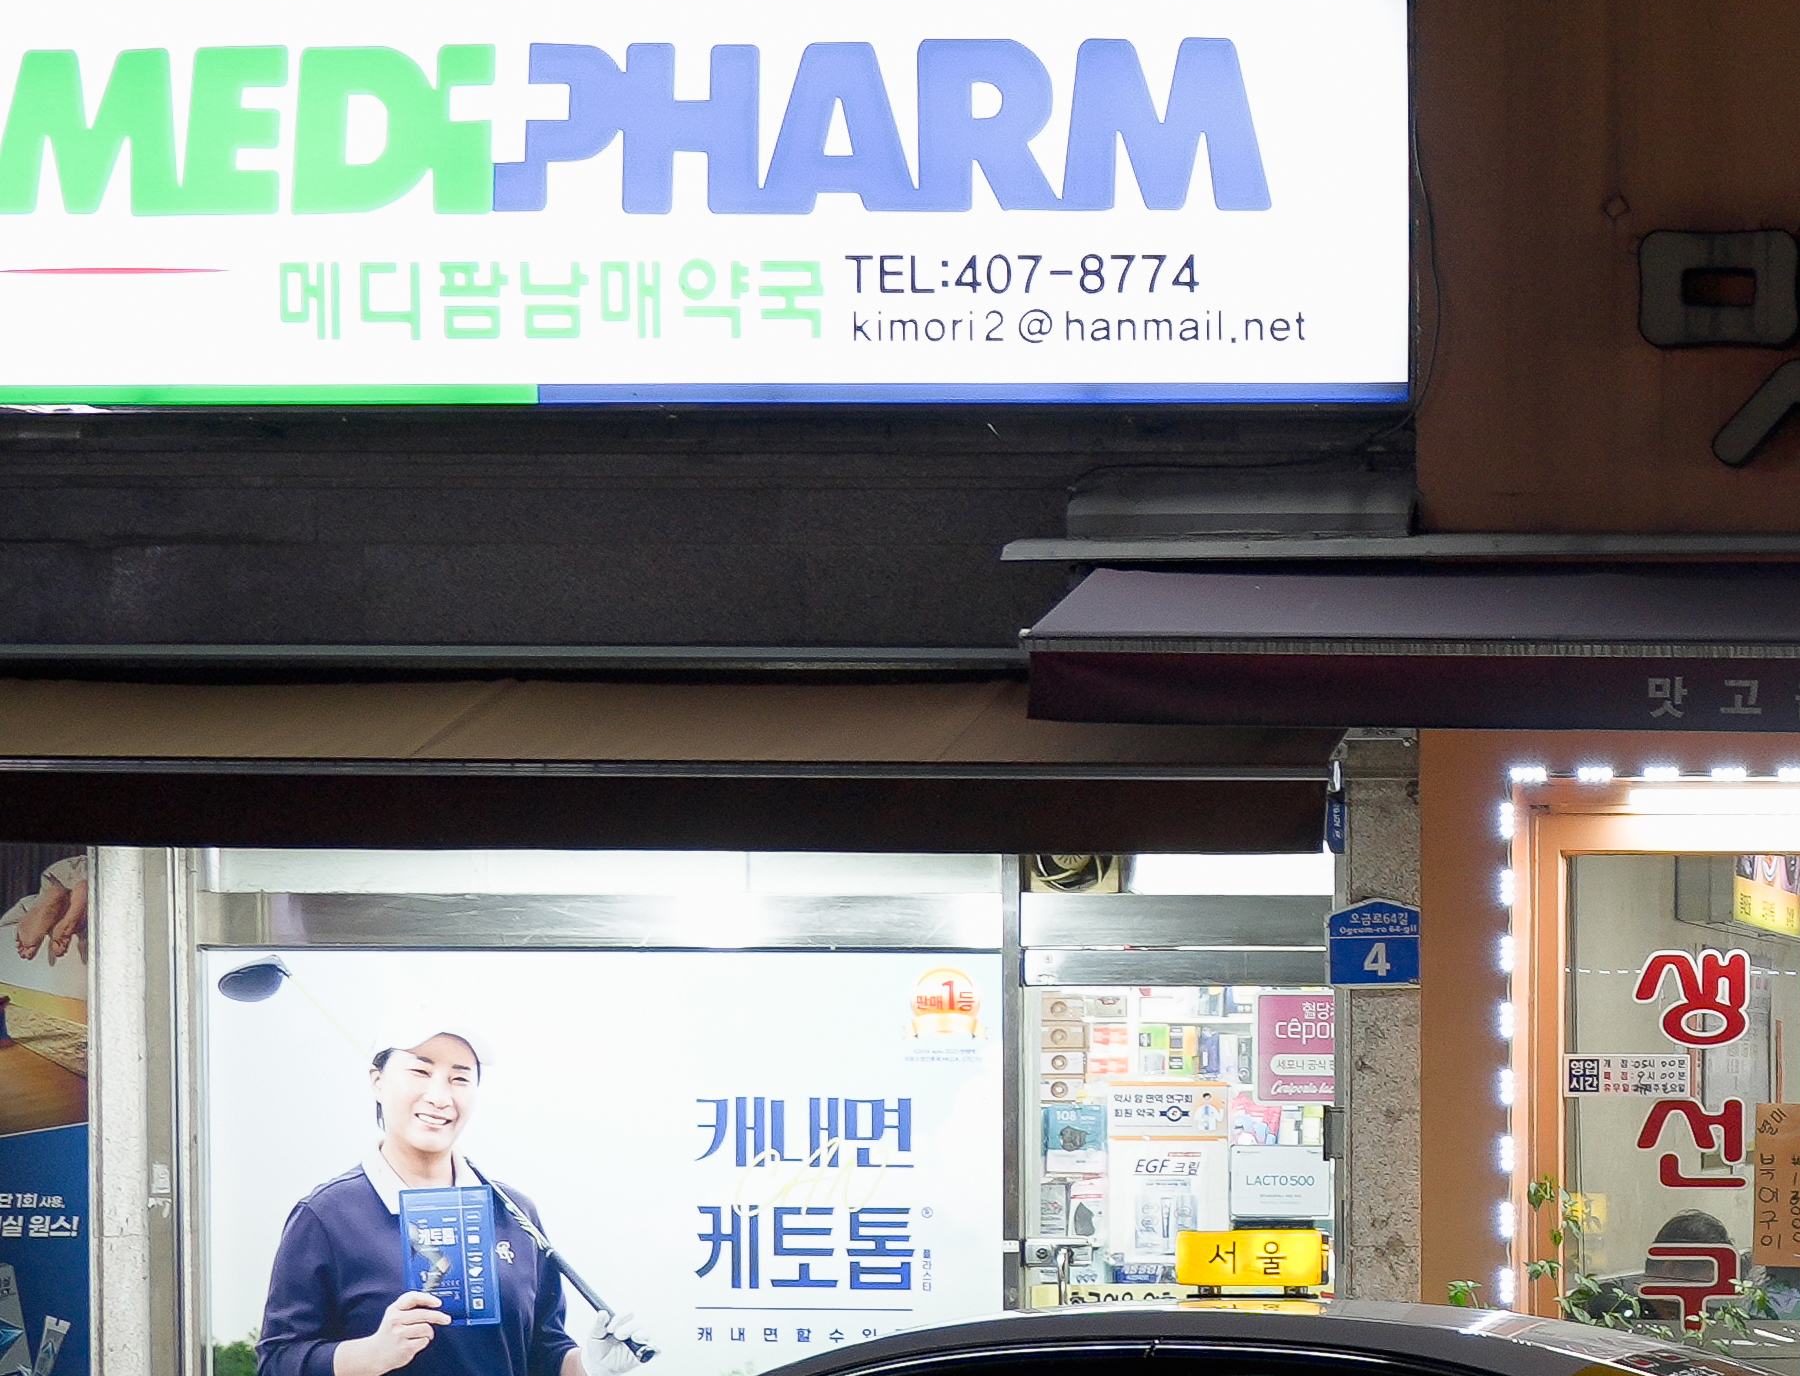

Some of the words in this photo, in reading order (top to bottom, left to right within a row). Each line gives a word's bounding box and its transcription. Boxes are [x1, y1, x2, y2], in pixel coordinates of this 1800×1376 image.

[845, 253, 1201, 296] TEL:407-8774
[278, 259, 827, 340] 메디팜남매약국
[1350, 912, 1408, 926] 오금로64길
[1363, 942, 1391, 976] 4
[1570, 1060, 1597, 1075] 영업
[1570, 1076, 1598, 1092] 시간
[694, 1096, 915, 1168] 캐내면
[1134, 1159, 1170, 1173] EGF
[0, 1215, 24, 1237] 실
[28, 1215, 80, 1238] 원스!
[694, 1204, 916, 1291] 케토톱
[1208, 1240, 1288, 1276] 서울
